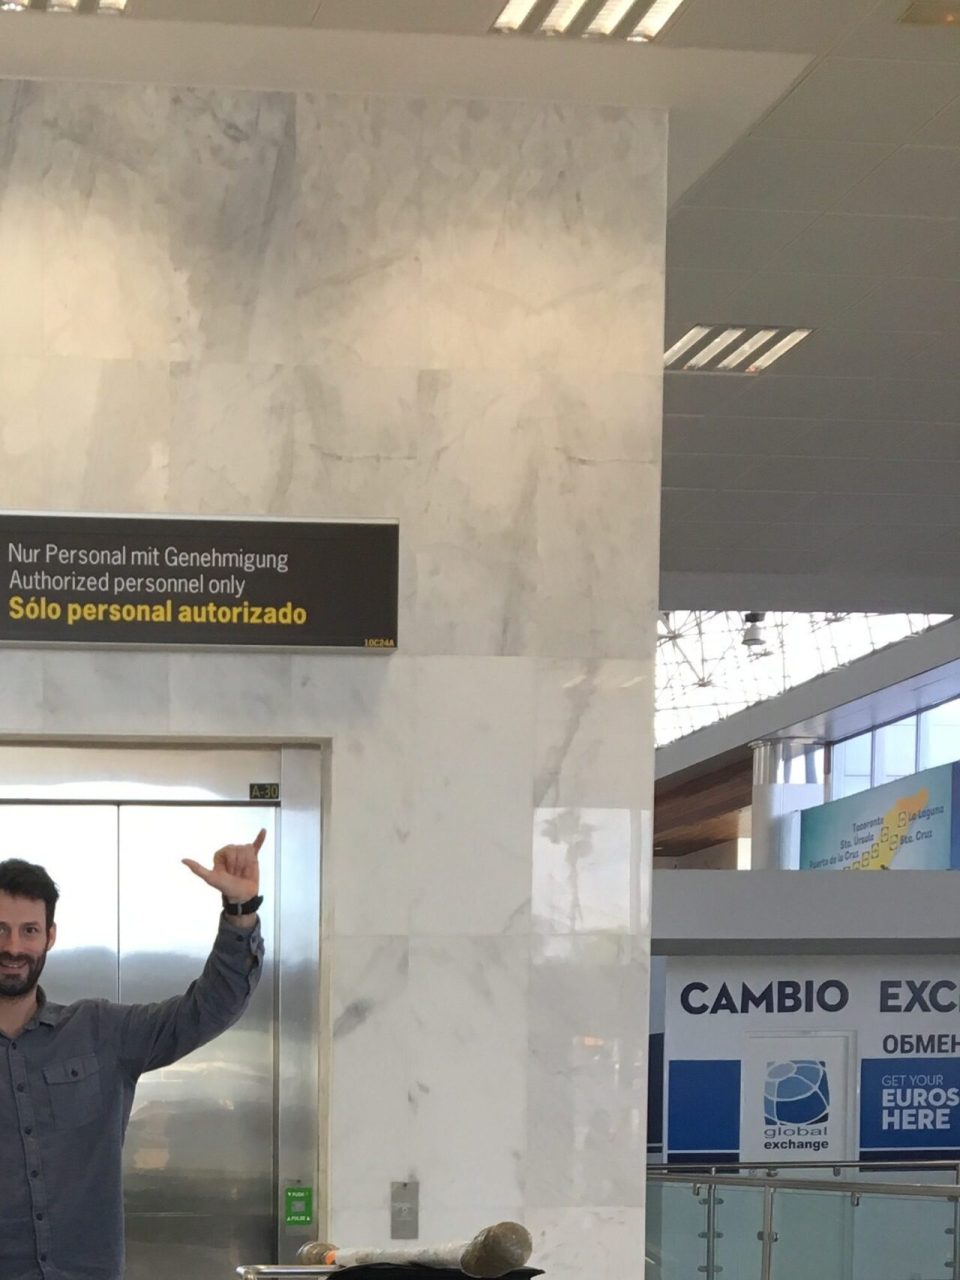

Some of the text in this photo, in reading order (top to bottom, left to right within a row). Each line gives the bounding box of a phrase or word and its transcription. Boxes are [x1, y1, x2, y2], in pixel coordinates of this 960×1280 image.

[8, 542, 289, 573] Nur Personal mit Genehmigung
[9, 569, 246, 598] Authorized personnel only
[9, 595, 307, 625] Sólo personal autorizado
[251, 784, 278, 798] A-30
[915, 828, 933, 842] Cruz
[680, 979, 960, 1015] CAMBIO EXC
[881, 1075, 944, 1087] GET YOUR
[881, 1087, 960, 1107] EUROS
[881, 1109, 951, 1130] HERE
[763, 1126, 828, 1139] global
[763, 1139, 829, 1152] exchange
